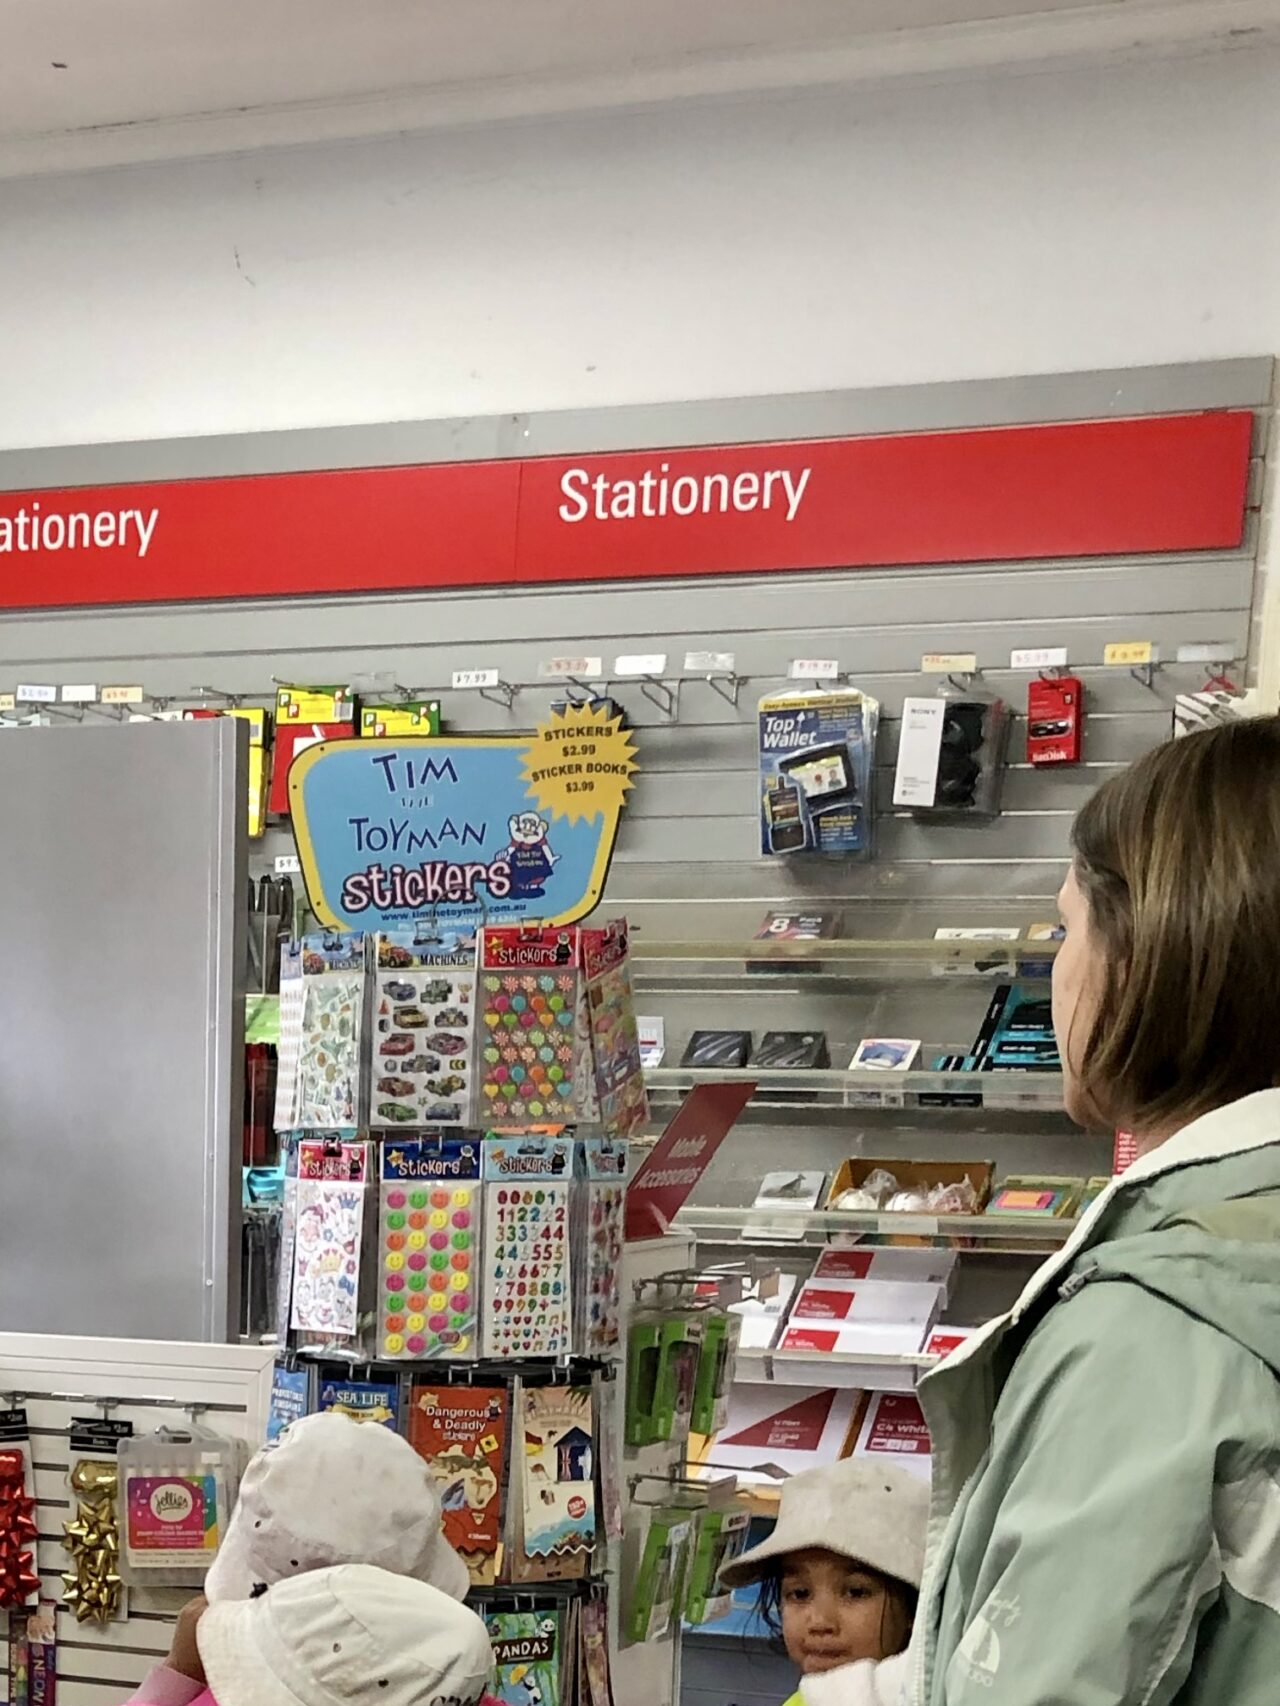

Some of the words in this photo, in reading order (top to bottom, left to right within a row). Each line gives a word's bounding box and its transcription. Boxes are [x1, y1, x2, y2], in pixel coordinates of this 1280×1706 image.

[558, 463, 812, 523] Stationery
[765, 717, 796, 733] Top
[544, 726, 613, 742] STICKERS
[763, 732, 816, 749] Wallet
[562, 744, 596, 757] $2.99
[372, 752, 461, 793] TIM
[531, 763, 583, 782] STICKER
[586, 762, 628, 775] BOOKS
[565, 780, 595, 793] $3.99
[348, 816, 487, 855] TOYMAN
[770, 917, 790, 933] 8
[420, 953, 468, 966] MACHINES
[498, 944, 558, 965] stickers
[399, 1156, 461, 1176] stickers
[499, 1157, 553, 1175] stickers
[336, 1391, 357, 1404] SEA
[361, 1392, 389, 1406] LIFE
[426, 1406, 490, 1420] Dangerous
[432, 1419, 442, 1429] &
[444, 1418, 486, 1433] Deadly
[491, 1640, 549, 1659] PANDAS
[32, 1658, 46, 1703] NEON
